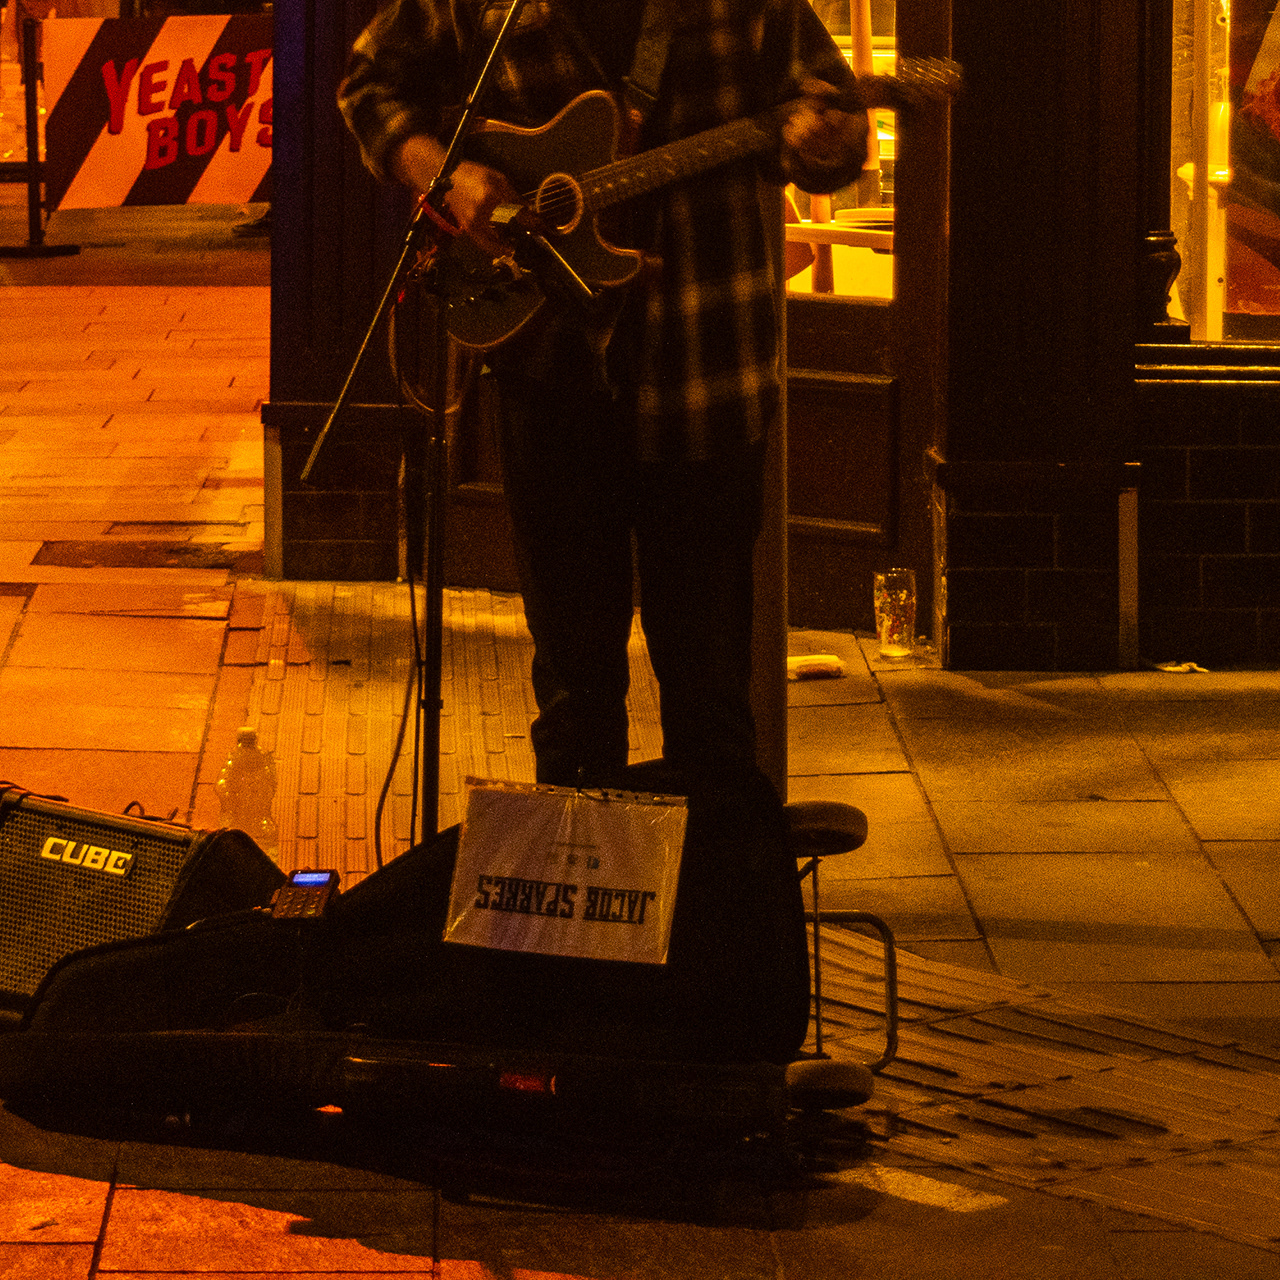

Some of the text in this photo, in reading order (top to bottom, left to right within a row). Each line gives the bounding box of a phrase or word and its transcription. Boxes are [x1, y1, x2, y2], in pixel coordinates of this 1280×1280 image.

[101, 49, 272, 135] YEAST
[41, 836, 132, 875] CUBE
[583, 885, 656, 925] JACOB
